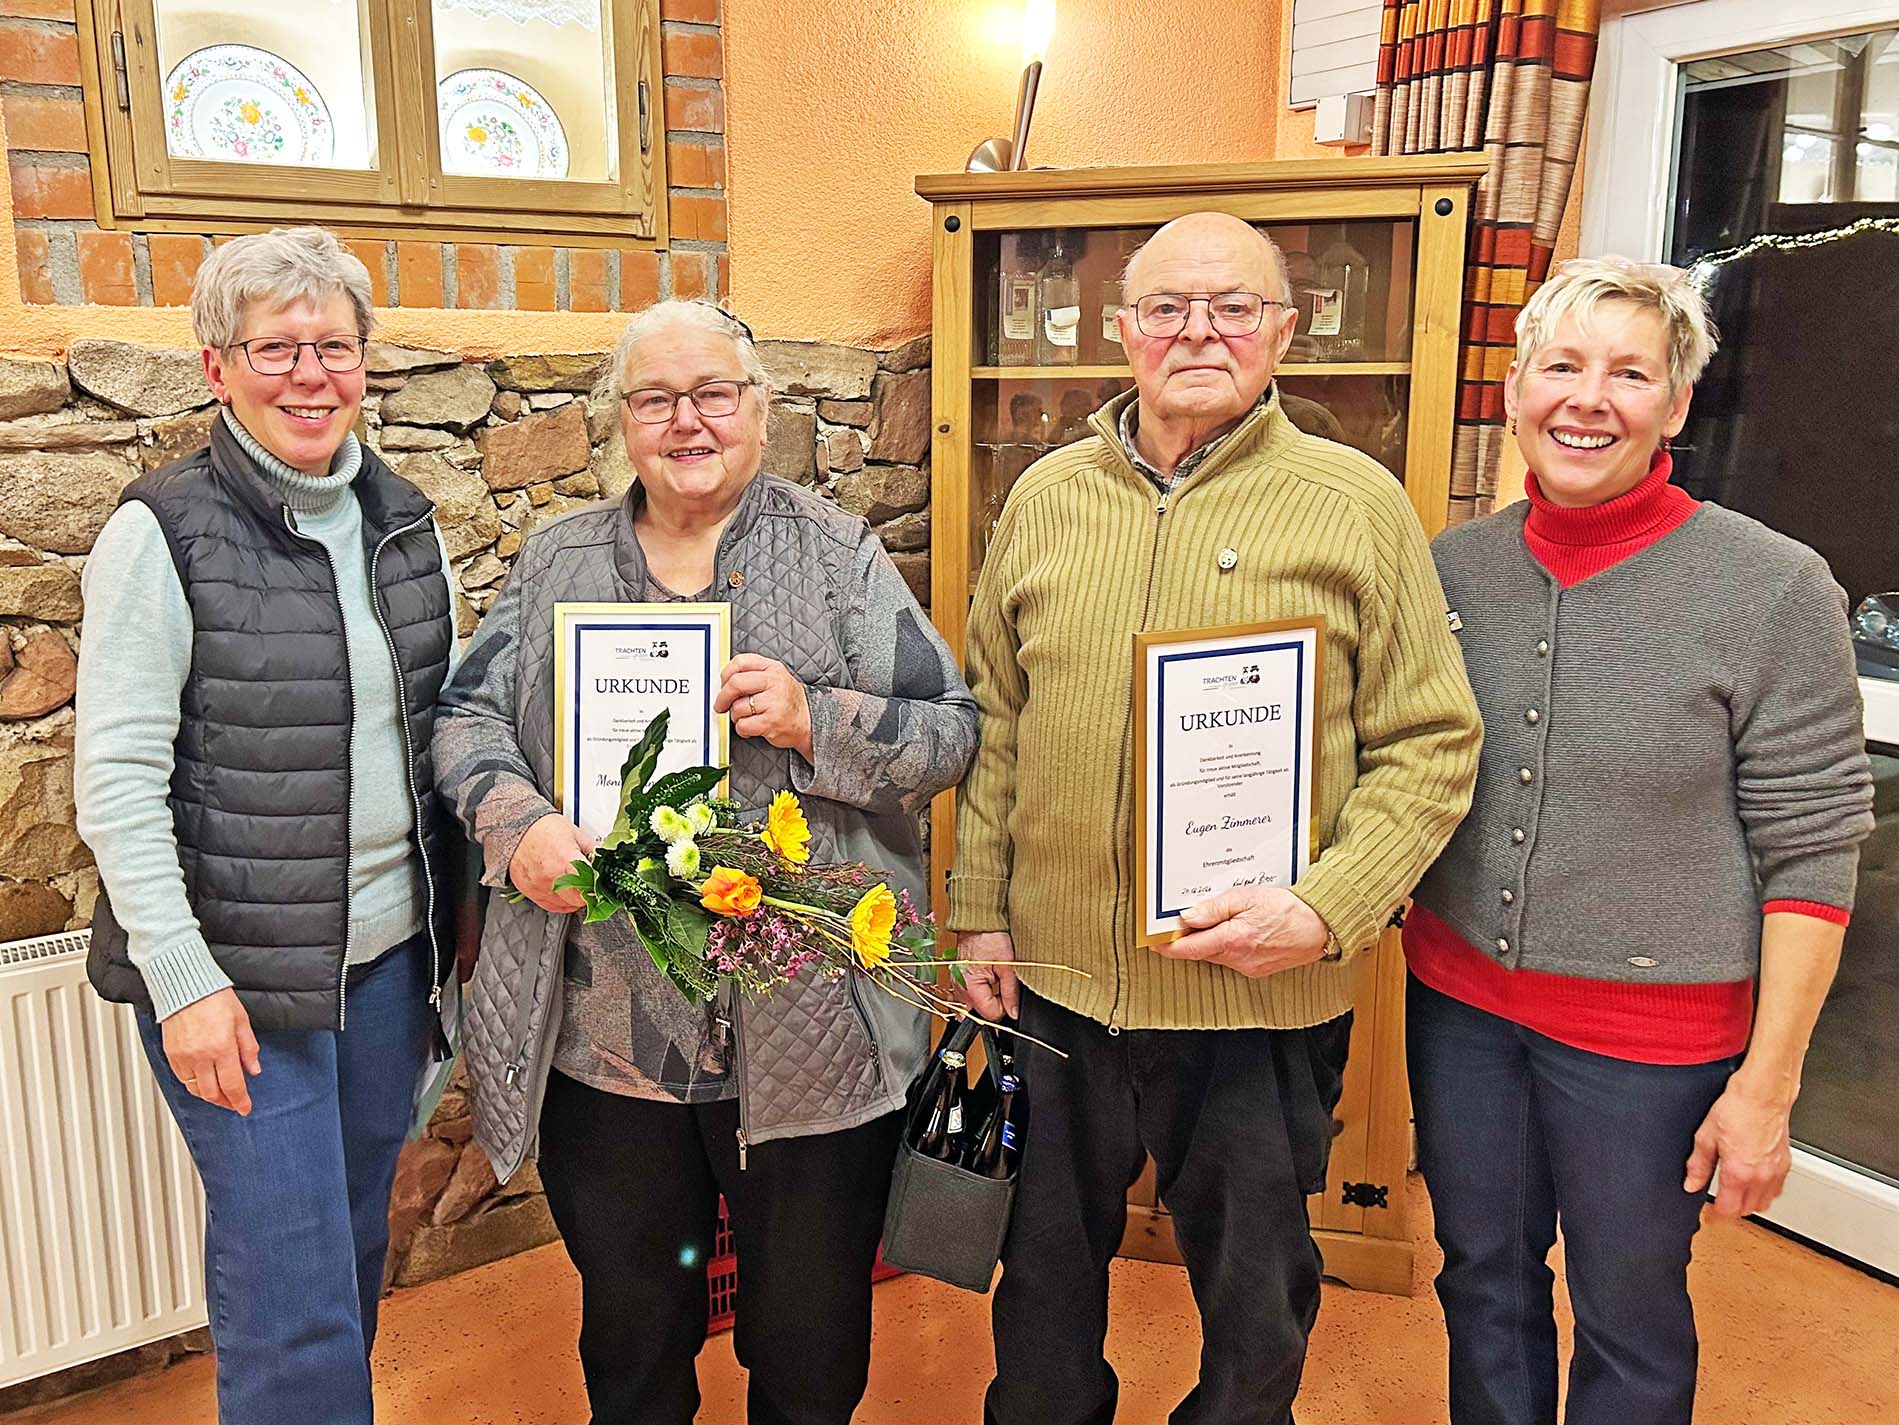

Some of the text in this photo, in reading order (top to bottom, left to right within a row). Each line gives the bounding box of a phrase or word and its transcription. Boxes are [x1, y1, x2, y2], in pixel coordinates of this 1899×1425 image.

[595, 678, 690, 694] URKUNDE
[1202, 675, 1237, 685] TRACHTEN
[1180, 704, 1282, 732] URKUNDE
[1185, 815, 1272, 837] Eugen Zimmerer
